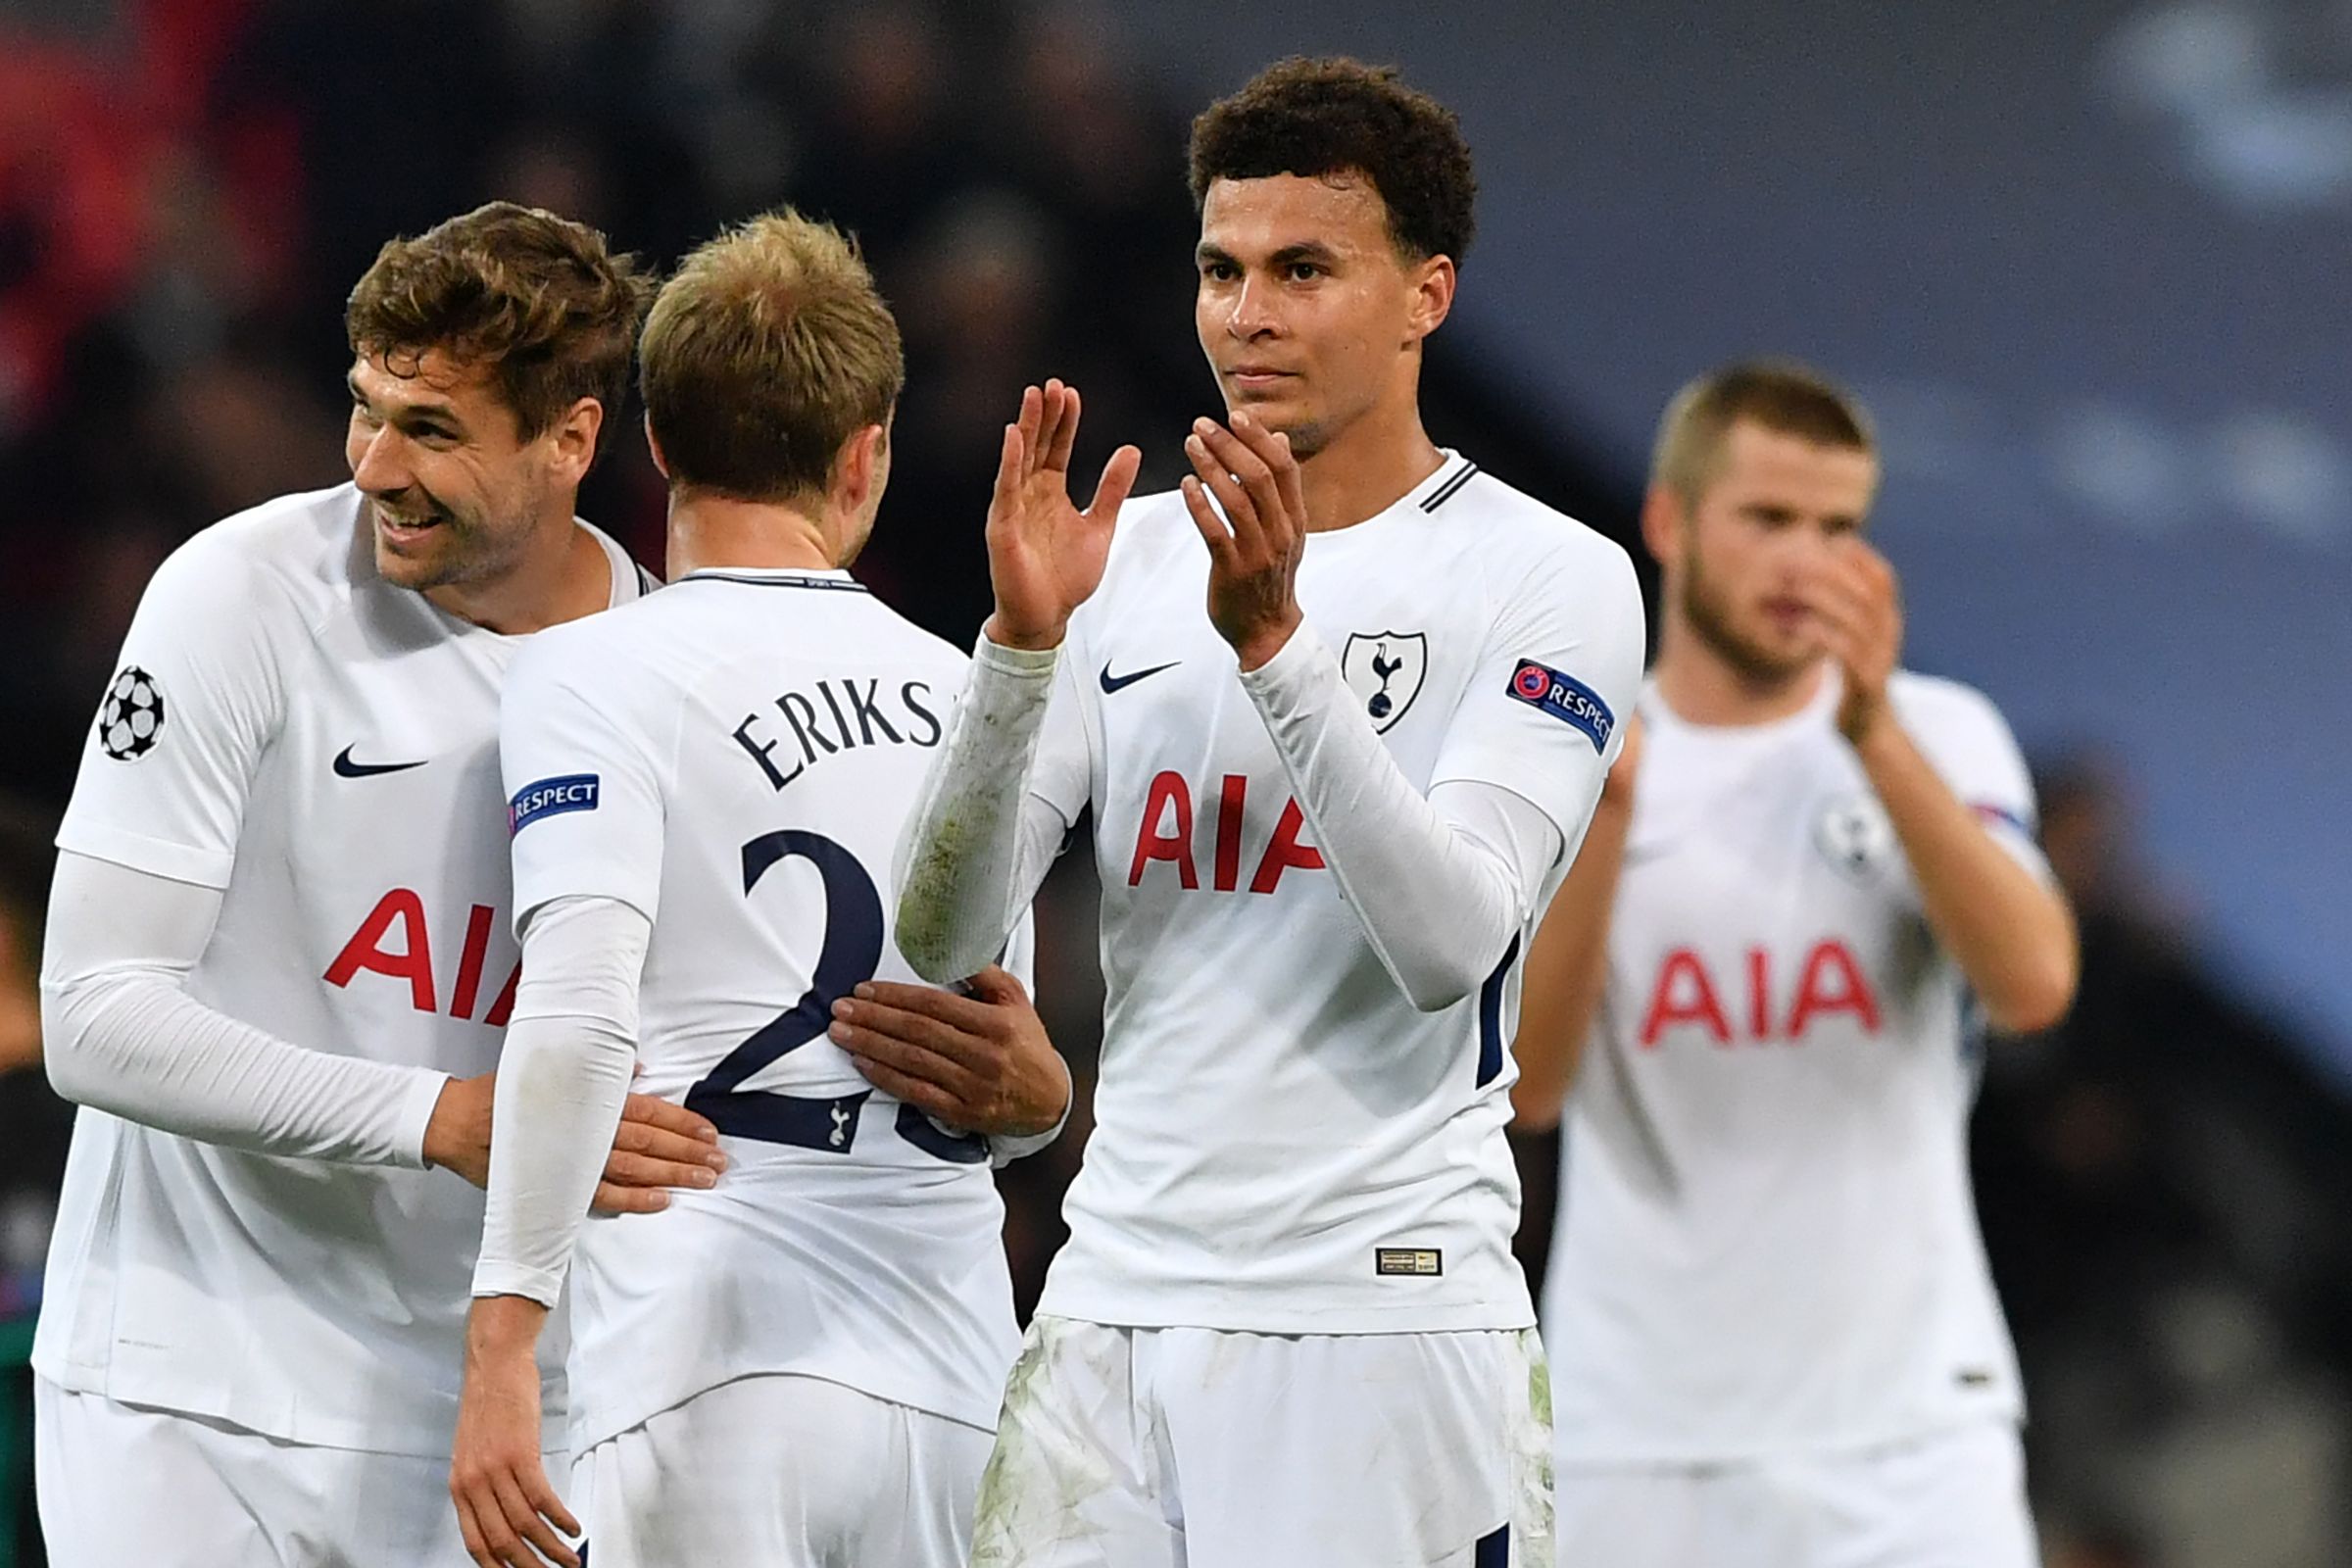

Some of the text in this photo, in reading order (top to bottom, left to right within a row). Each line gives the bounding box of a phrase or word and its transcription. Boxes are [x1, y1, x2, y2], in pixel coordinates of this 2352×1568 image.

[732, 678, 958, 793] ERIKS
[515, 784, 597, 821] RESPECT
[322, 888, 522, 1027] AI
[684, 829, 991, 1163] 2
[1639, 939, 1881, 1047] AIA
